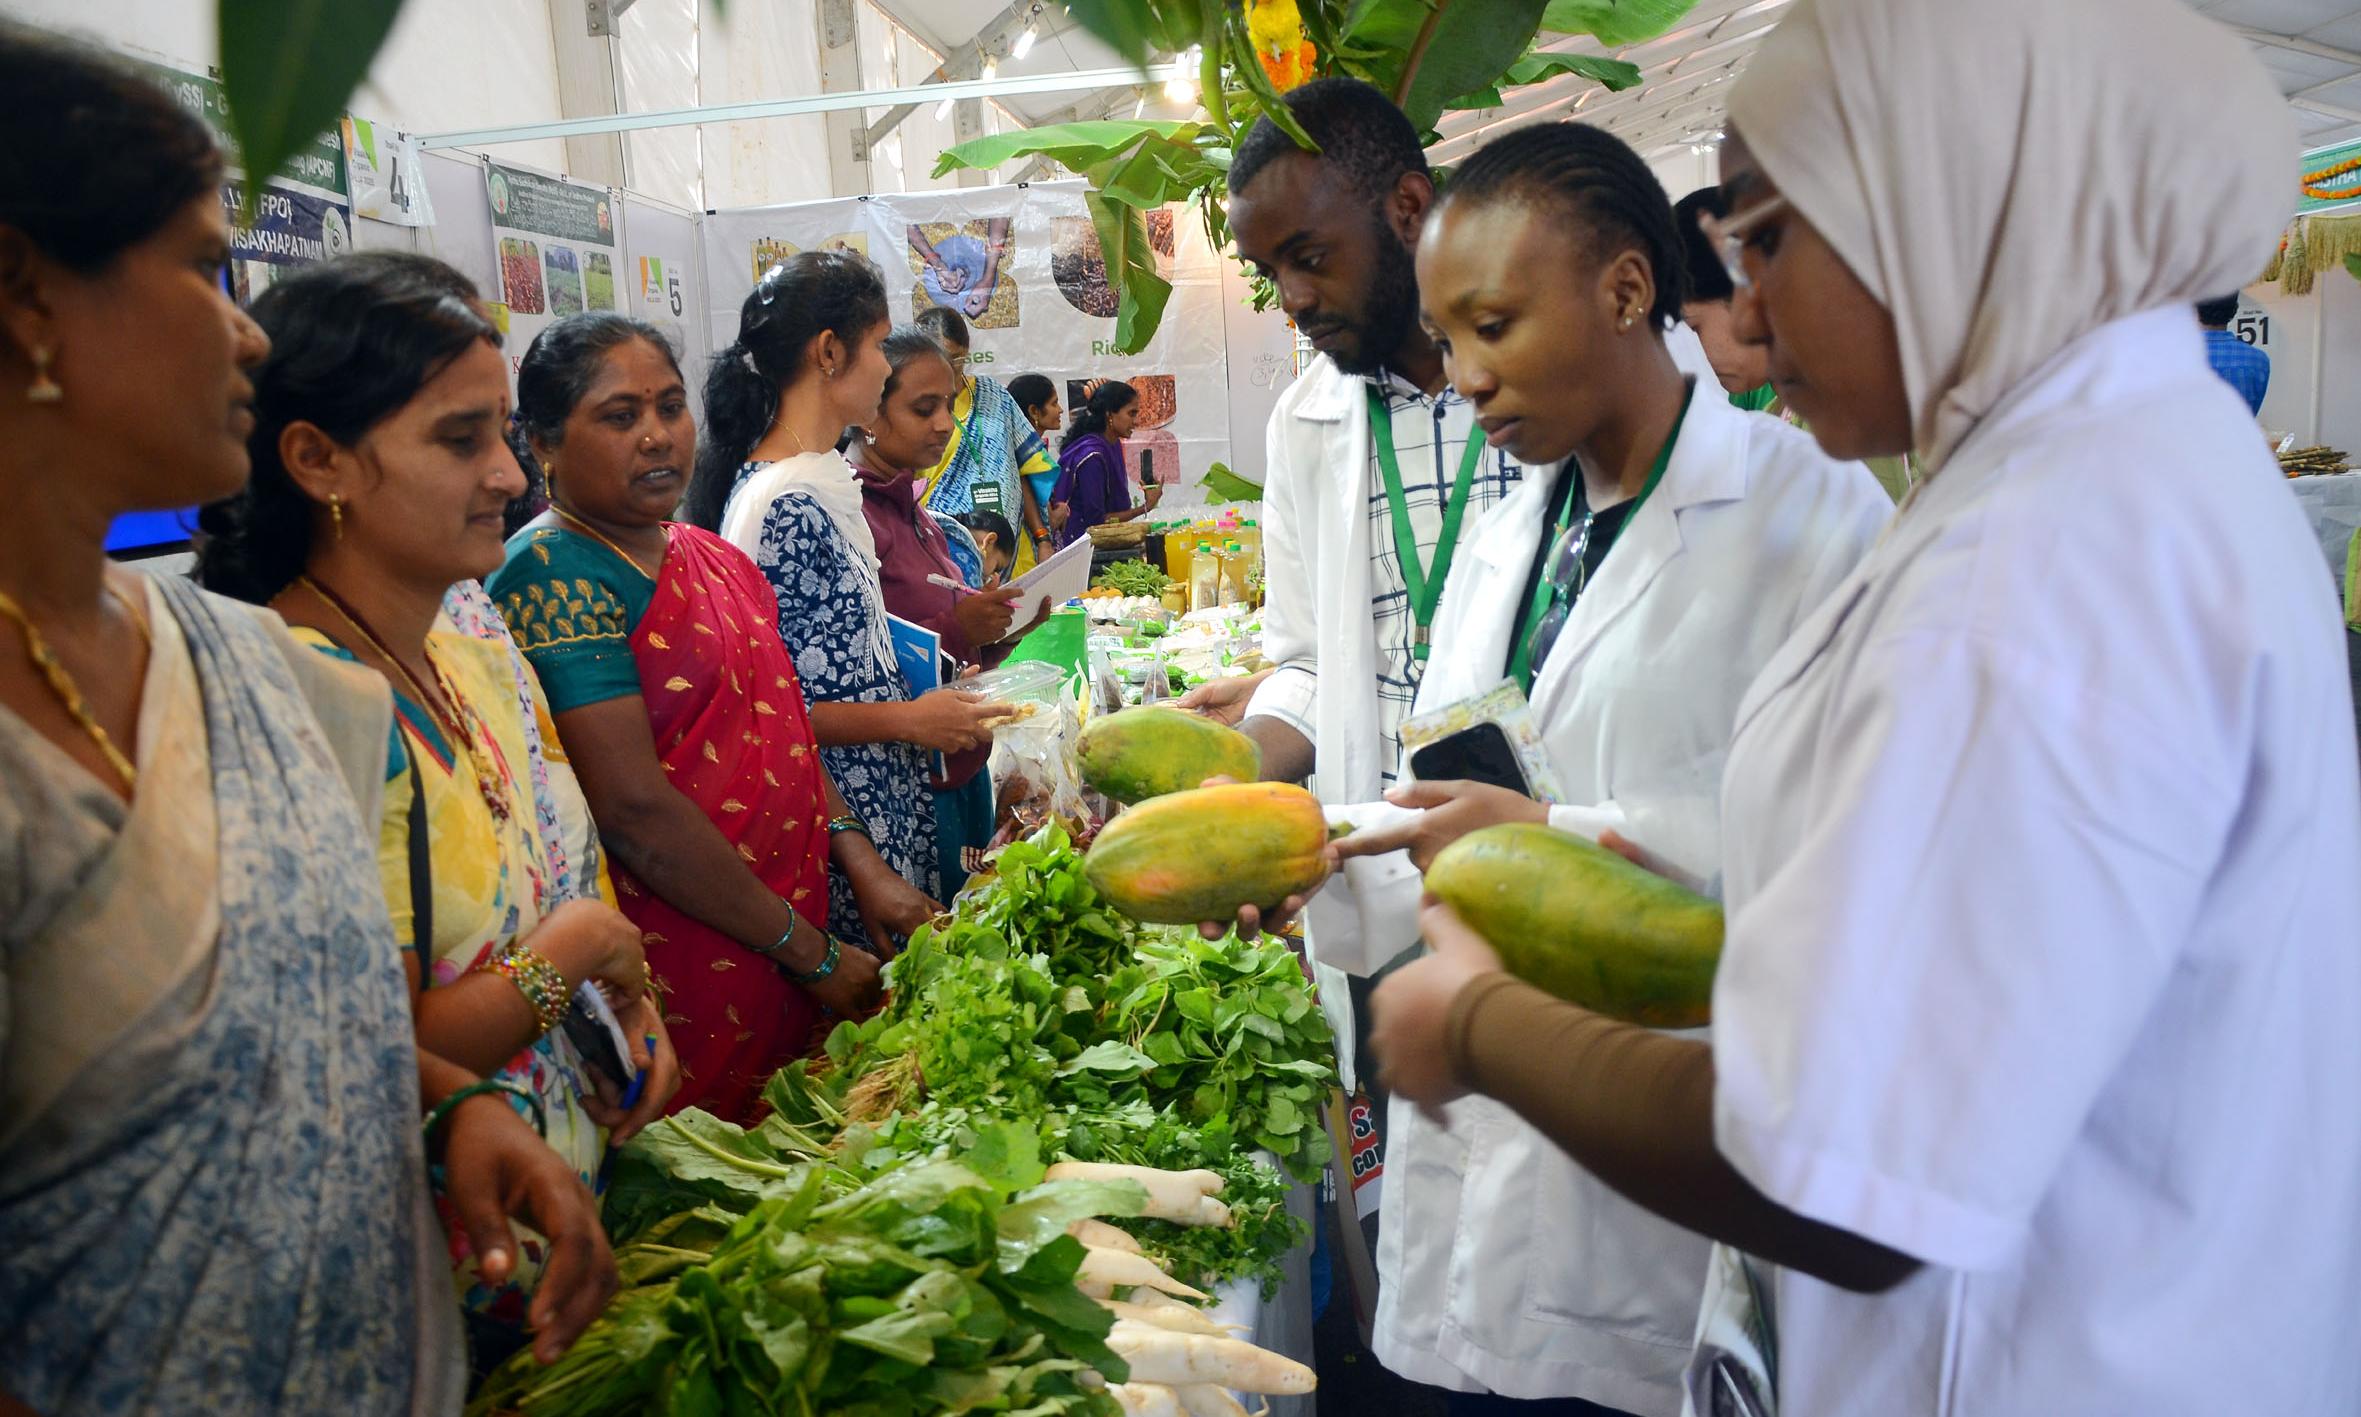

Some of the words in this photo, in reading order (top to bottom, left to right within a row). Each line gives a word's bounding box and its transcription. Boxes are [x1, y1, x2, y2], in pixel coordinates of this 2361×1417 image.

[389, 156, 410, 214] 4
[668, 277, 682, 317] 5
[2236, 316, 2269, 346] 51
